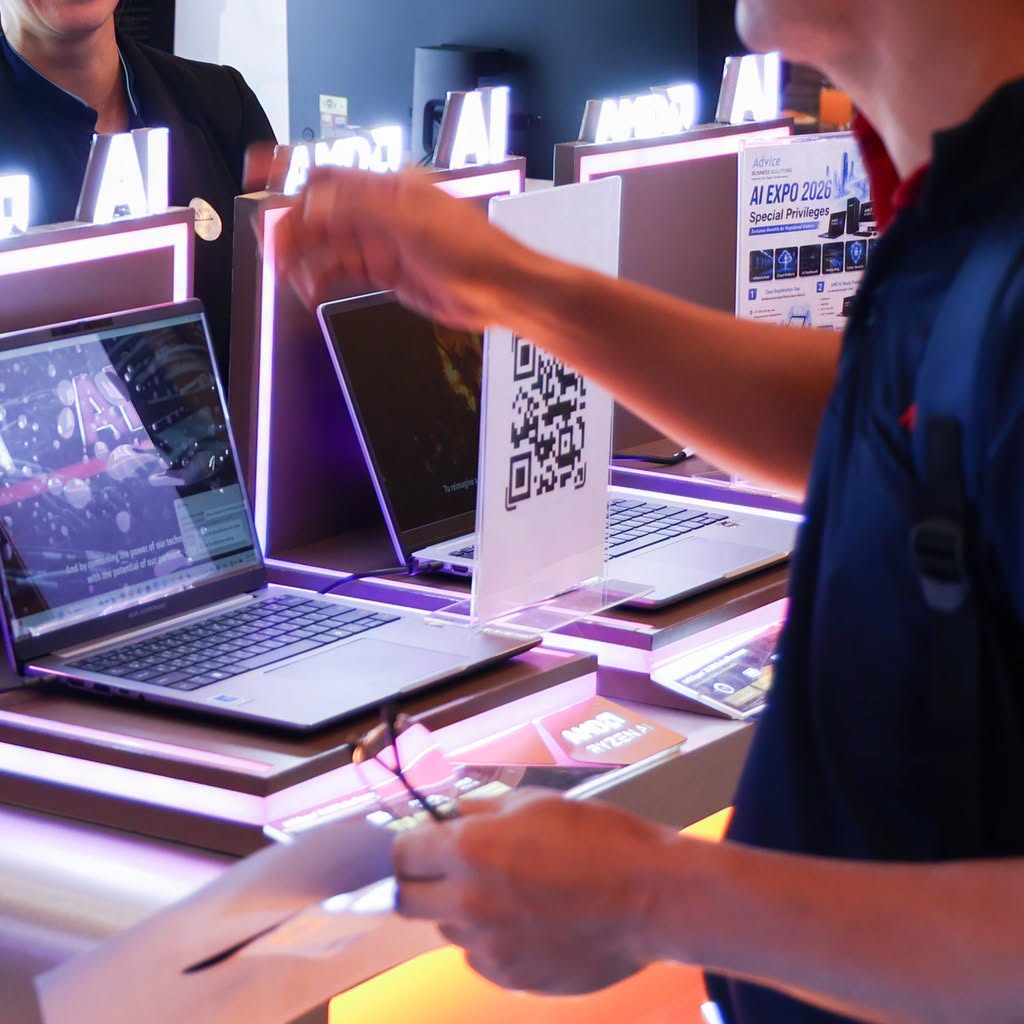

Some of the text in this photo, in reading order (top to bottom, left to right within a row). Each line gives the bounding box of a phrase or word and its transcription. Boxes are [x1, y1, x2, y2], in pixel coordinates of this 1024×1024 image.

[724, 52, 782, 125] AI
[444, 86, 510, 171] AI
[752, 157, 781, 169] Advice
[86, 127, 169, 225] AI
[749, 180, 832, 206] AI EXPO 2026
[749, 207, 830, 225] Special Privileges
[818, 282, 823, 291] 2
[148, 541, 155, 552] of
[140, 557, 148, 569] of
